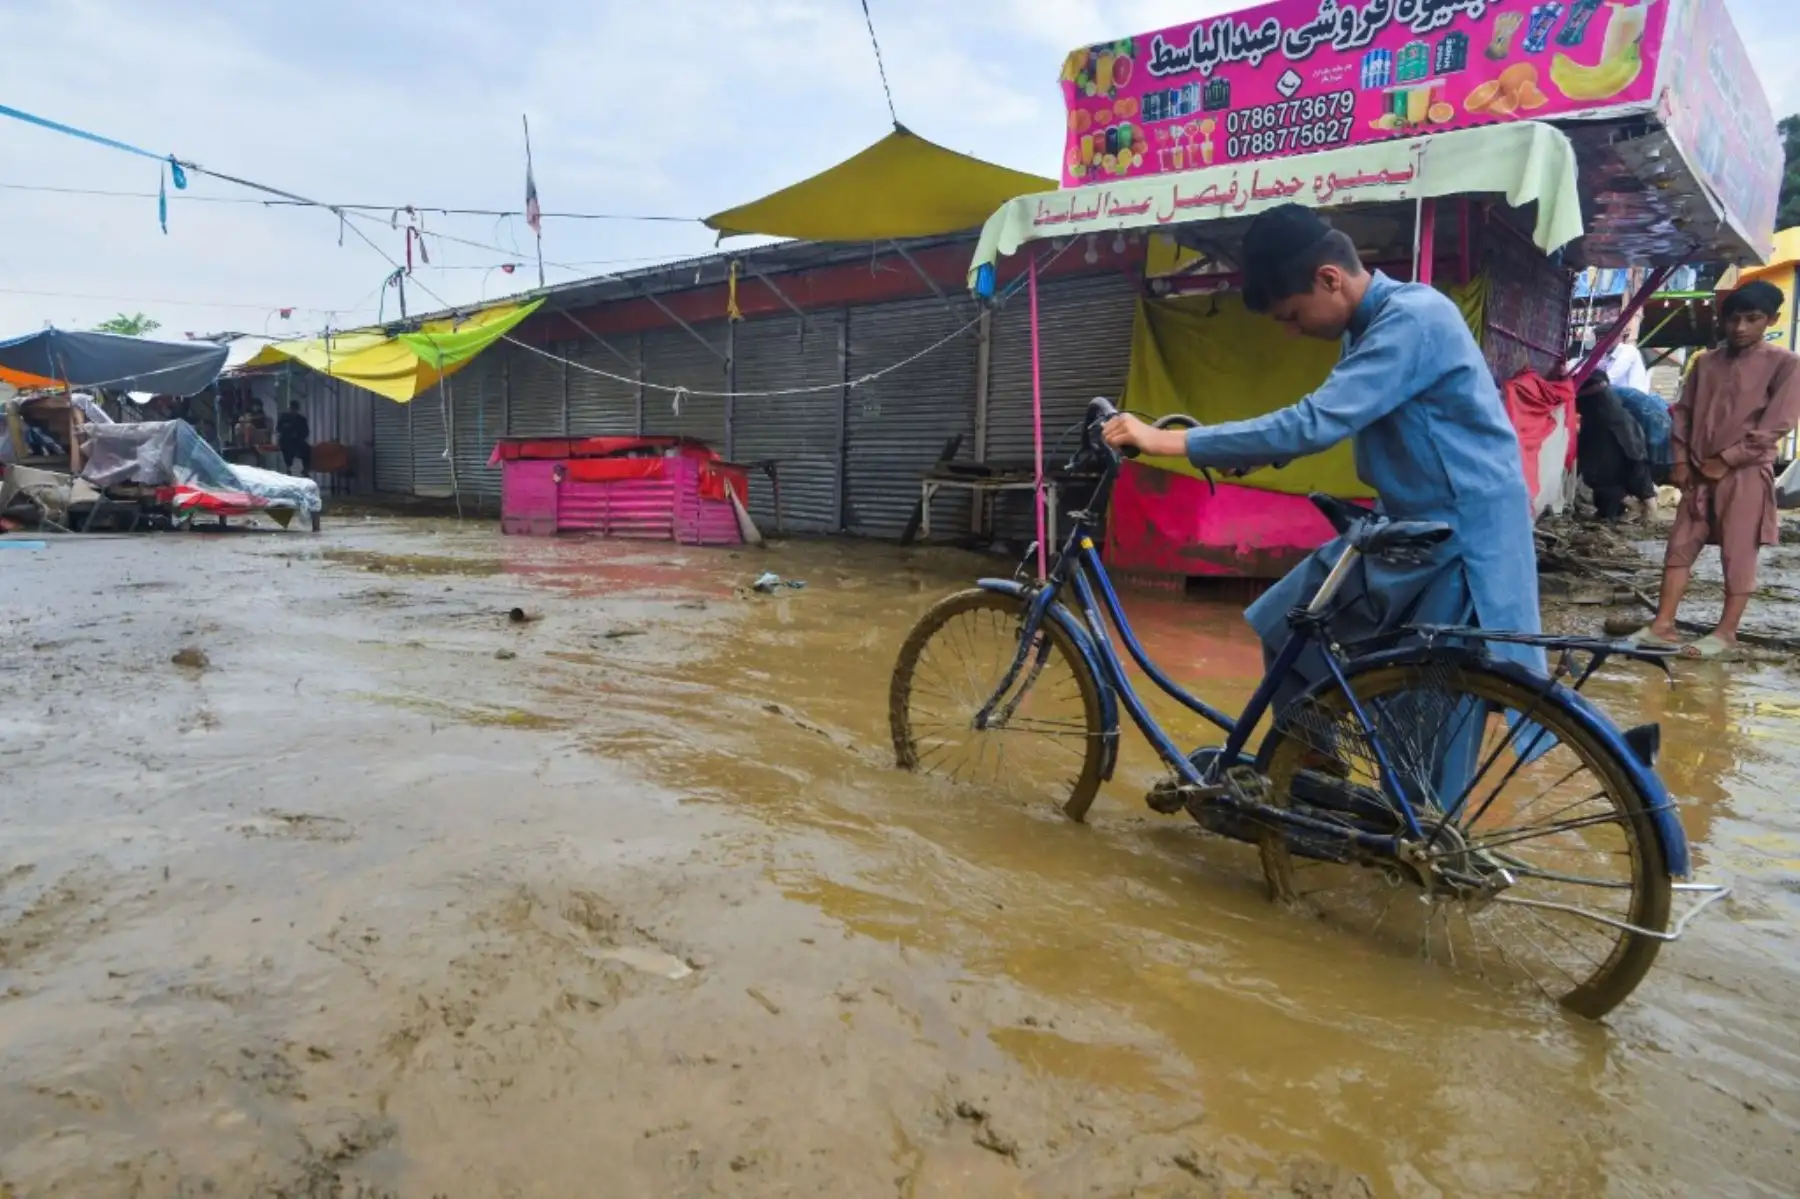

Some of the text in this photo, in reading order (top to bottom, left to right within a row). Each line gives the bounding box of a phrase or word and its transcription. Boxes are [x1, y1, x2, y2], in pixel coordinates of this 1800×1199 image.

[1147, 20, 1280, 76] عبدالباسط
[1282, 0, 1393, 59] فروشی
[1227, 91, 1355, 133] 0786773679
[1227, 117, 1354, 159] 0788775627
[1033, 191, 1154, 234] عبدالباسط
